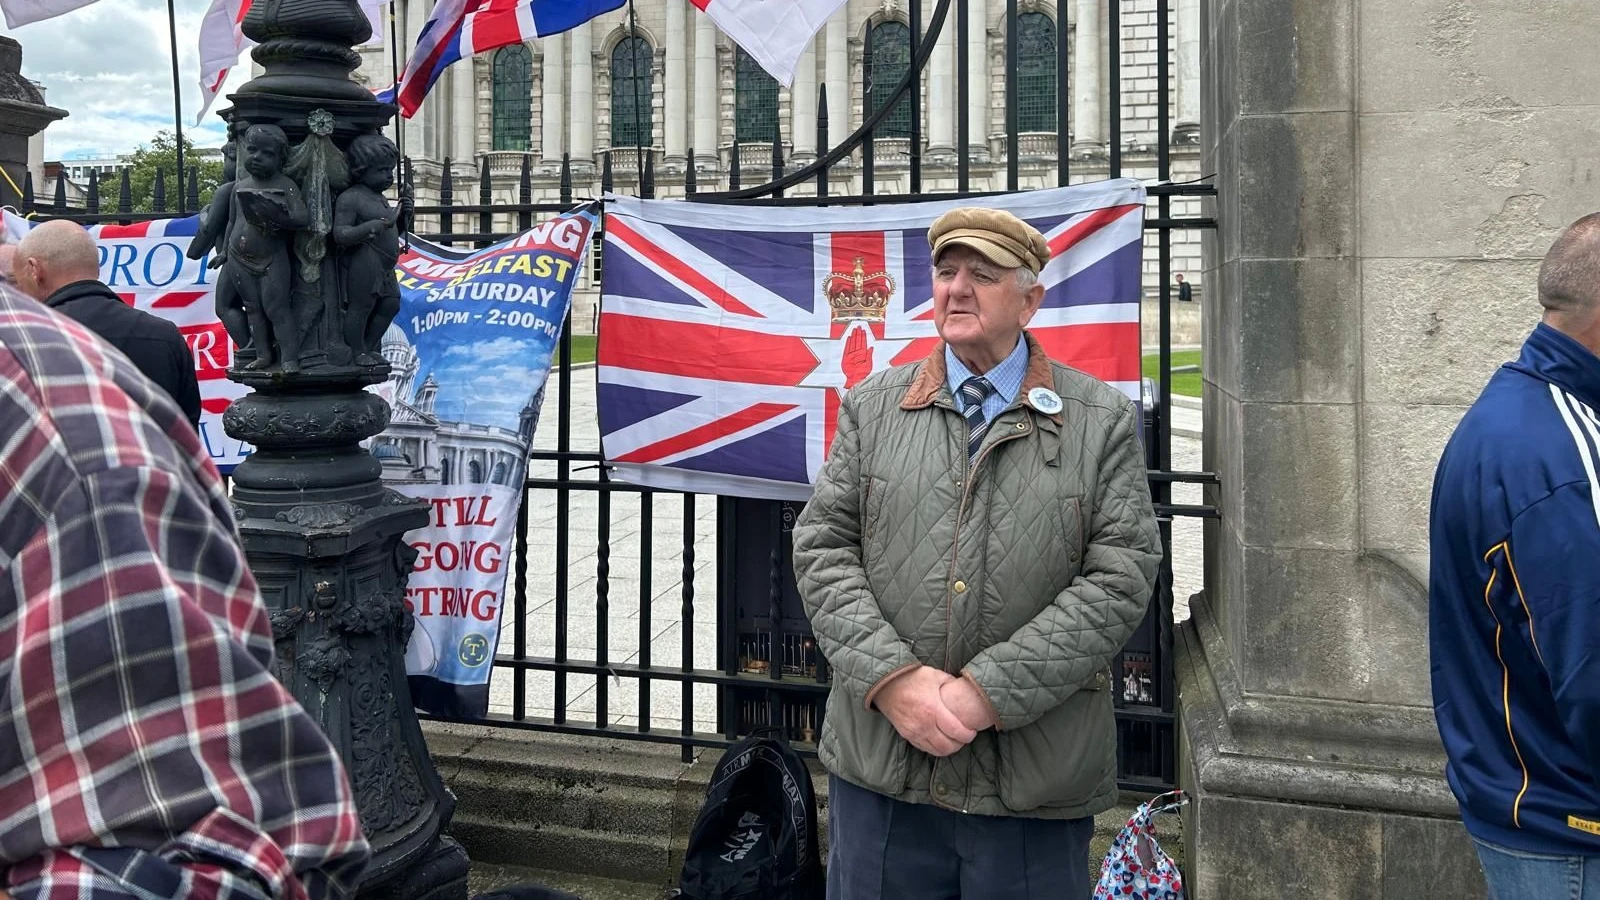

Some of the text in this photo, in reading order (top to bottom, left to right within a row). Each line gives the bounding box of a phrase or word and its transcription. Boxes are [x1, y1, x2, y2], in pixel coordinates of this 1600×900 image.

[447, 254, 573, 287] BELFAST
[426, 282, 556, 308] SATURDAY
[411, 309, 468, 334] 1:00PM
[486, 309, 557, 338] 2:00PM
[419, 495, 497, 527] TILL
[404, 587, 497, 622] STRNG
